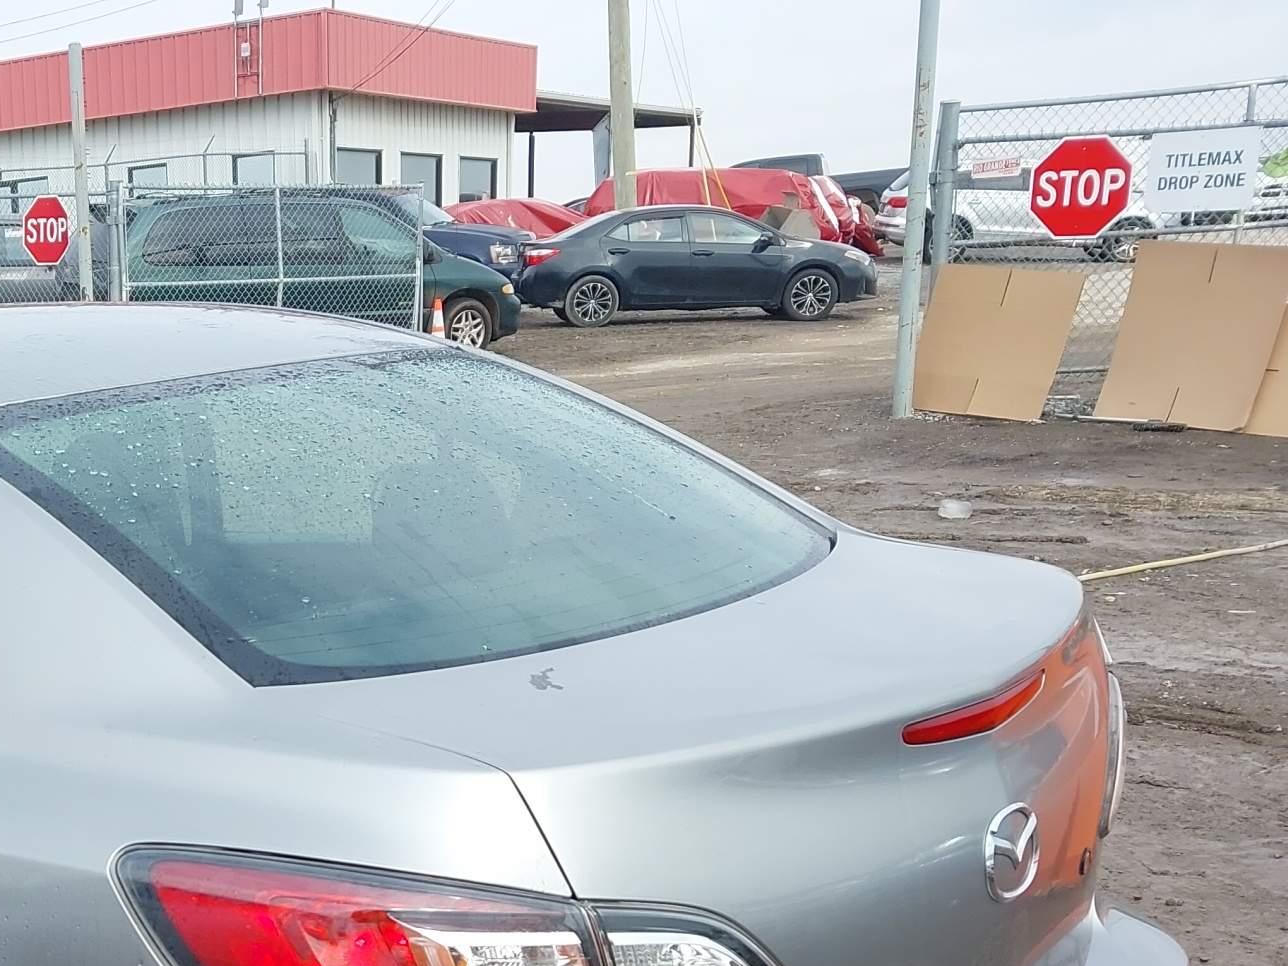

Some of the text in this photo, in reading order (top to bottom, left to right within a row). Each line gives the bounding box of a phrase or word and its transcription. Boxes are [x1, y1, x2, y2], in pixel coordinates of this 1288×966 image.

[1165, 150, 1244, 168] TITLEMAX
[1035, 168, 1126, 208] STOP
[1157, 172, 1246, 191] DROP ZONE
[26, 217, 67, 243] STOP
